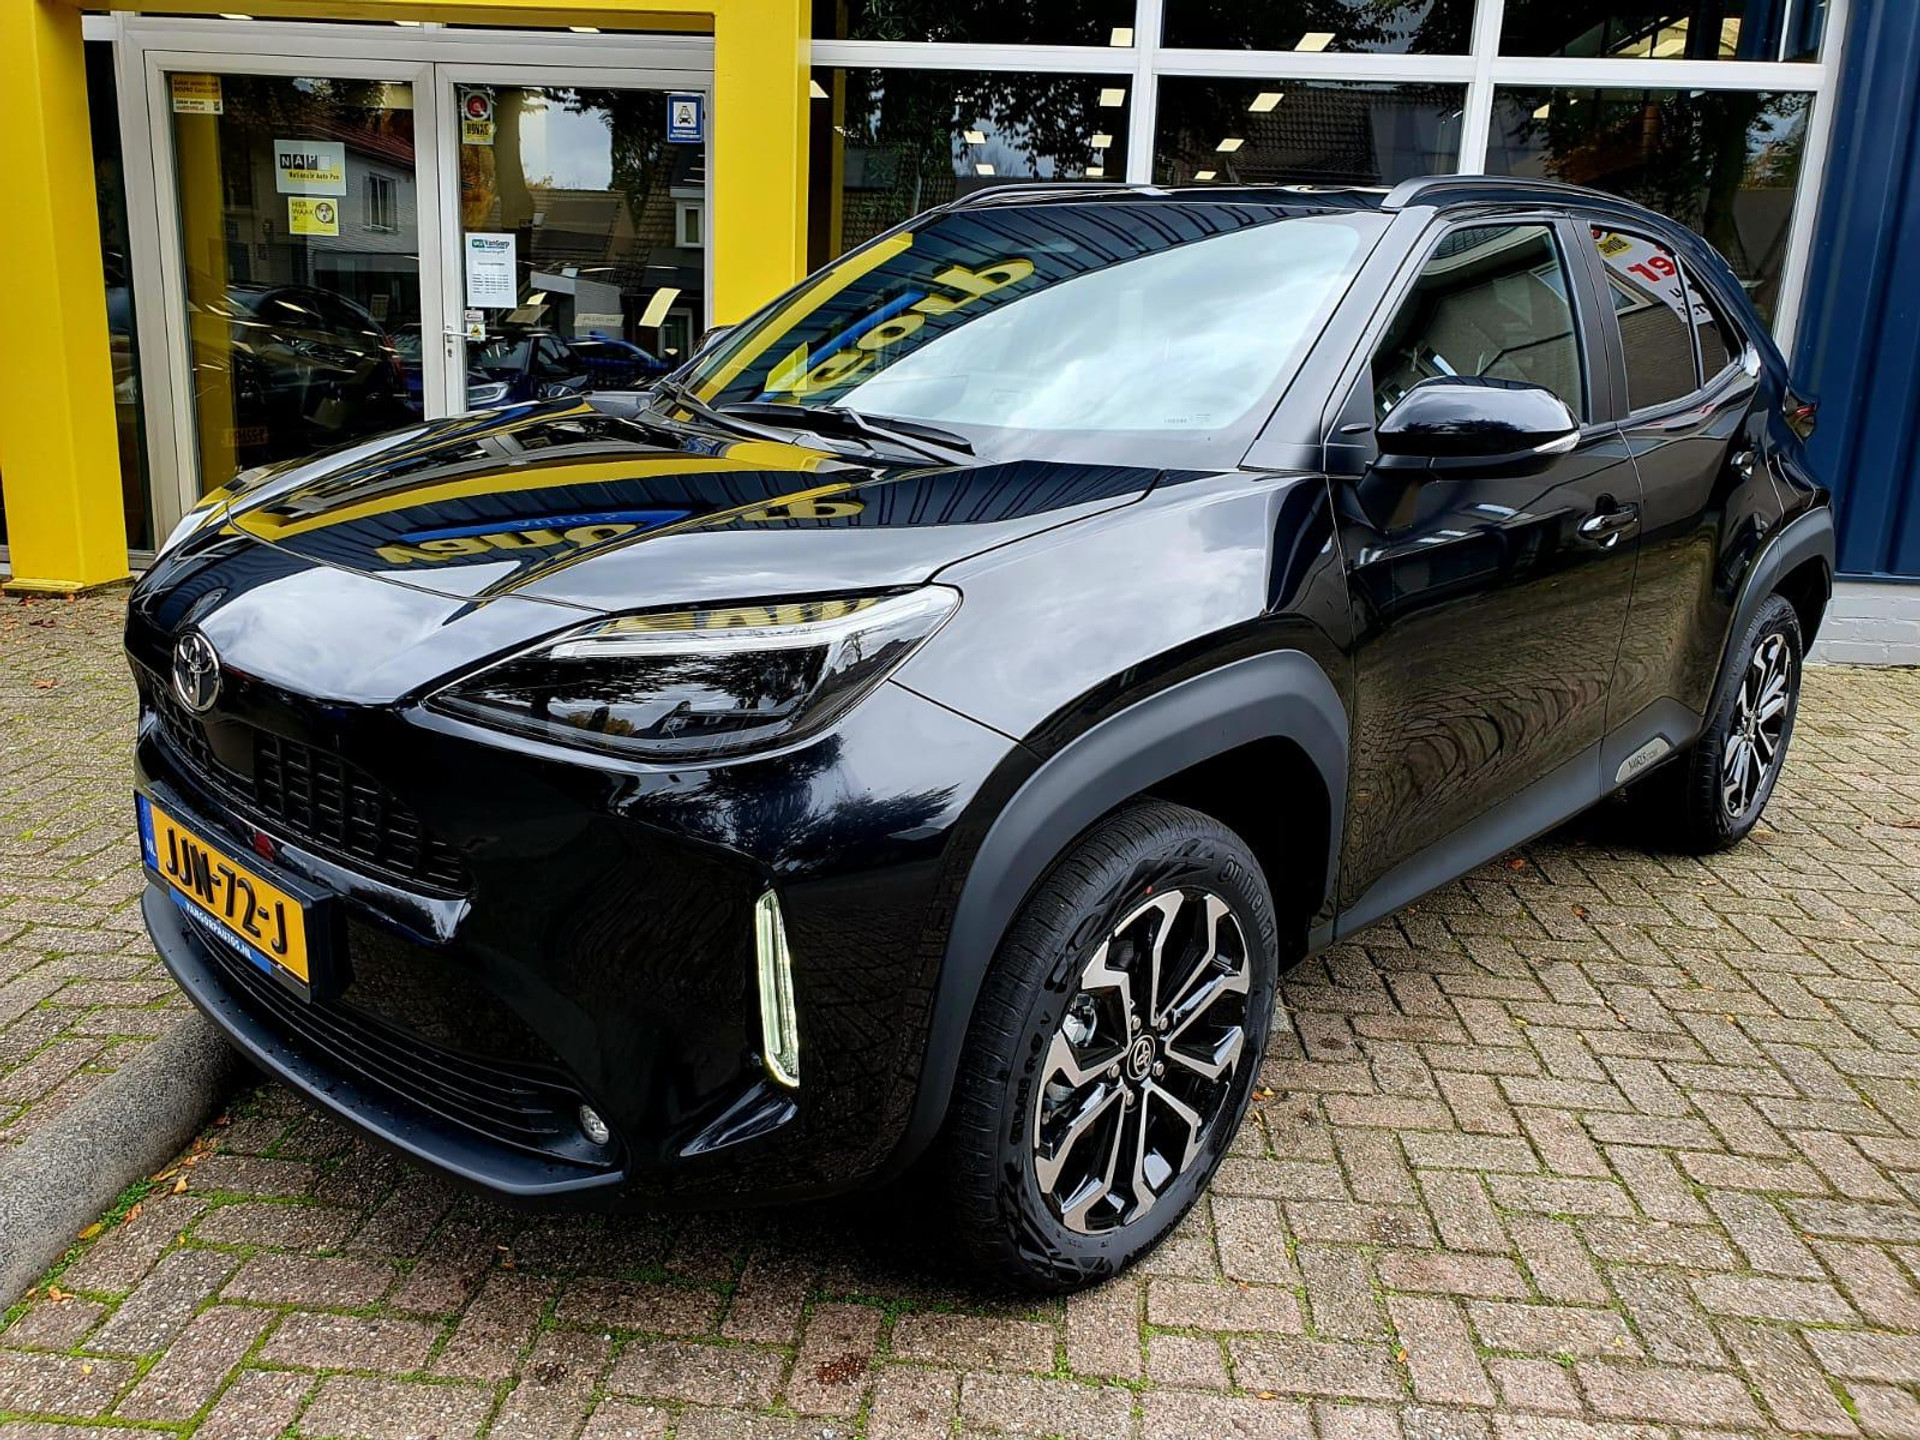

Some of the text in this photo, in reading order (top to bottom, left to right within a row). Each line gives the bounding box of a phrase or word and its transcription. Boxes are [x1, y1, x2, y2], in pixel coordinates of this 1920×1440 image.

[288, 170, 315, 179] Nationale
[316, 172, 328, 180] Auto
[166, 826, 288, 955] JJN-72-J
